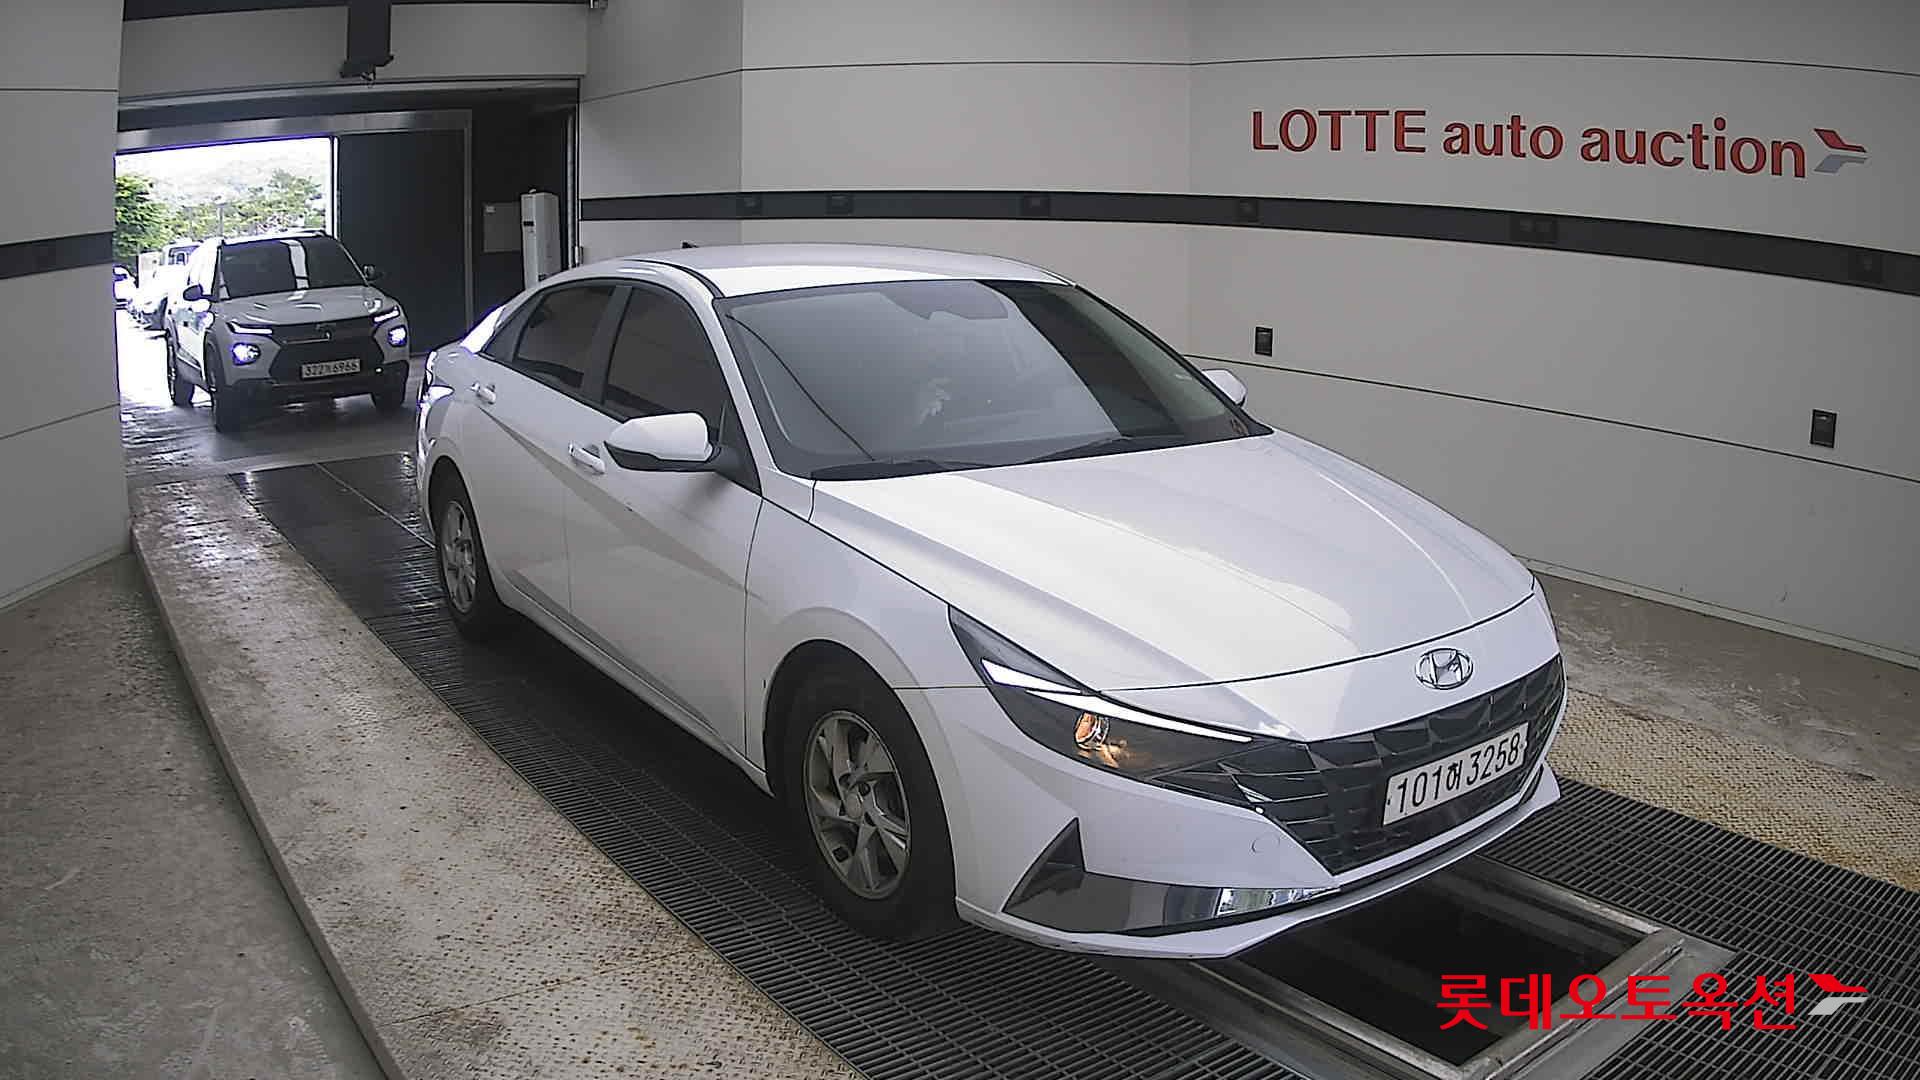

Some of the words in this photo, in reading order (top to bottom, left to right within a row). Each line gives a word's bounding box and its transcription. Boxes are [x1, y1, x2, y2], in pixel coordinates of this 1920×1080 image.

[1252, 109, 1427, 153] LOTTE
[1442, 114, 1564, 160] auto
[1580, 116, 1807, 179] auction
[1466, 732, 1521, 786] 3258
